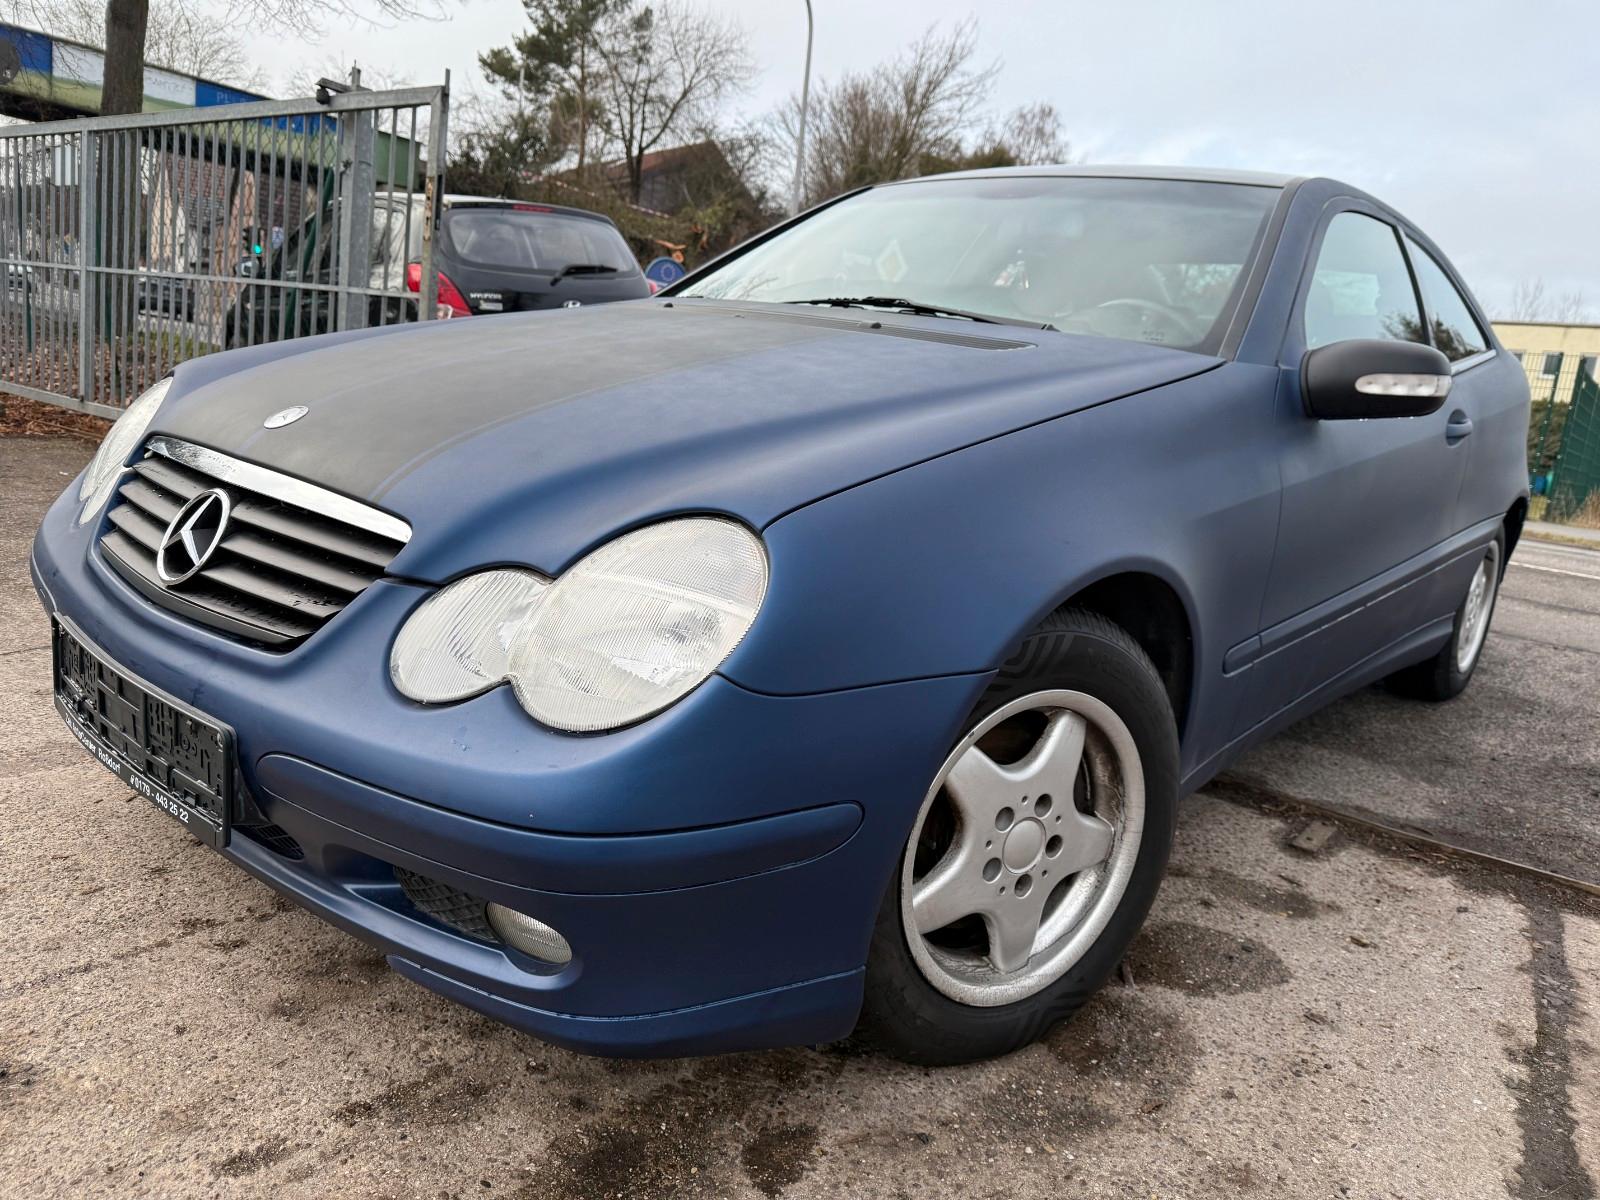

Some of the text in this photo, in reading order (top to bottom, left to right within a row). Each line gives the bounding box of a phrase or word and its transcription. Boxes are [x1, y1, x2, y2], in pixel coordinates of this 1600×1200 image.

[134, 777, 150, 797] 0179
[155, 792, 168, 809] 443
[169, 803, 178, 816] 25
[179, 808, 189, 823] 22
